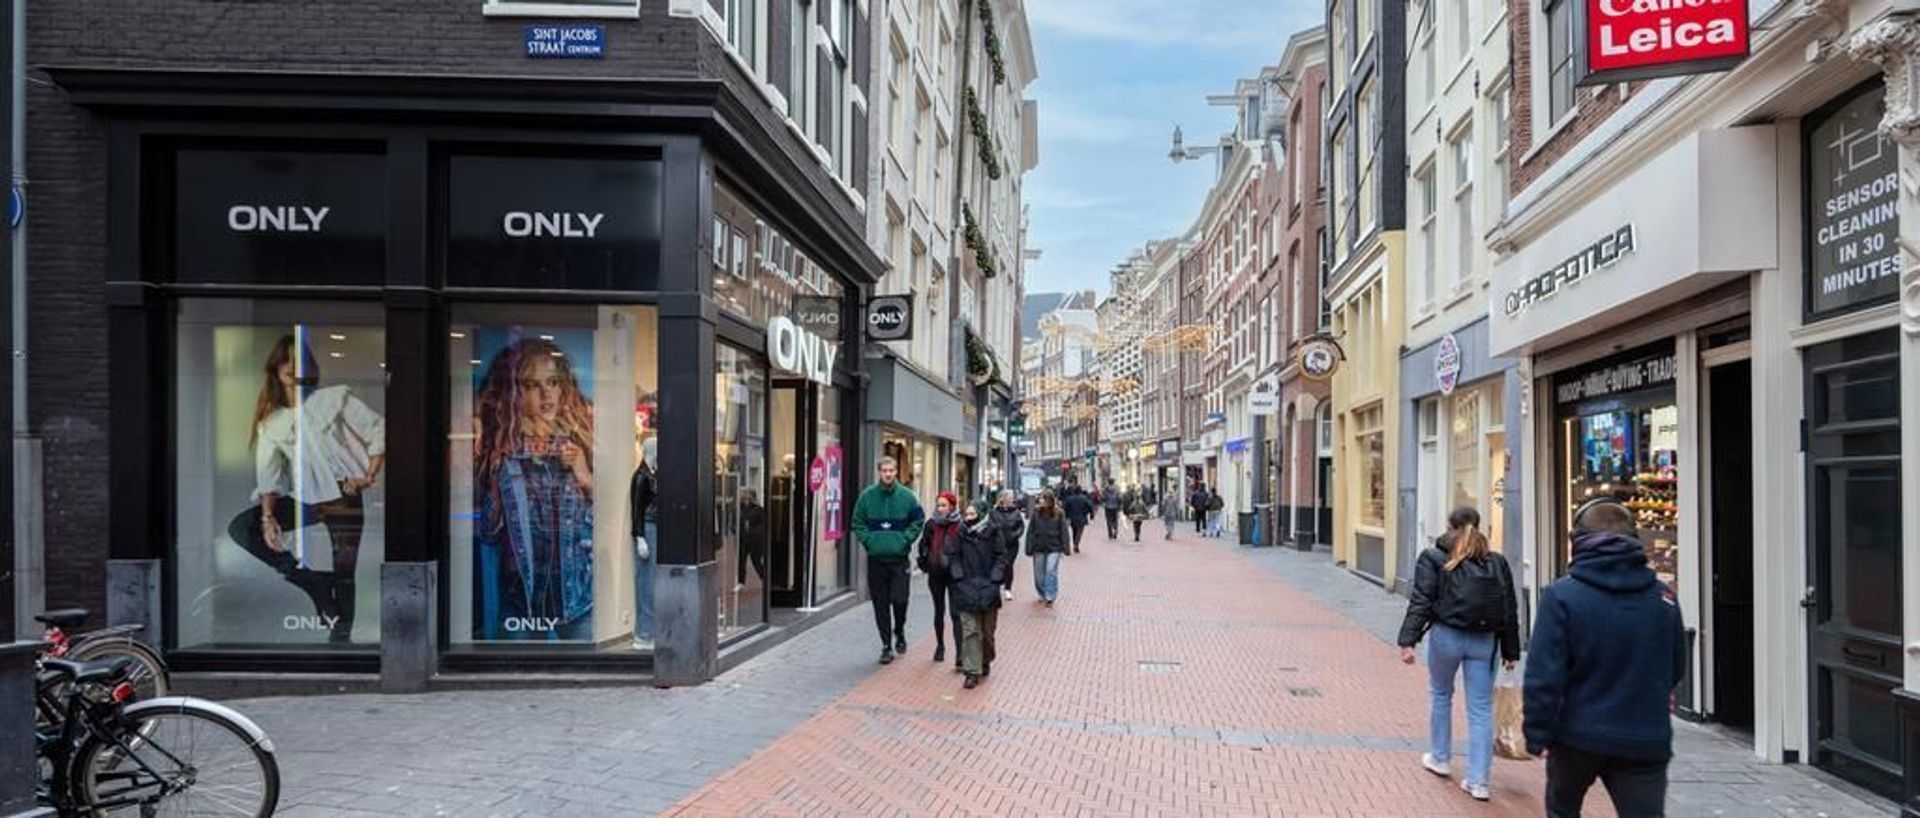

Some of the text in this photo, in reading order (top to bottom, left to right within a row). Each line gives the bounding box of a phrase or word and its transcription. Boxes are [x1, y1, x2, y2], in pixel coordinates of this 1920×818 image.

[527, 41, 565, 54] STRAAT
[533, 28, 597, 42] SINT JACOBS
[1600, 18, 1735, 56] Leica
[1826, 172, 1898, 217] SENSOR
[228, 205, 330, 231] ONLY
[504, 212, 604, 237] ONLY
[1839, 233, 1884, 264] IN 30
[1823, 254, 1903, 294] MINUTES
[870, 312, 906, 324] ONLY
[767, 316, 837, 386] ONLY
[283, 615, 340, 630] ONLY
[504, 616, 559, 631] ONLY
